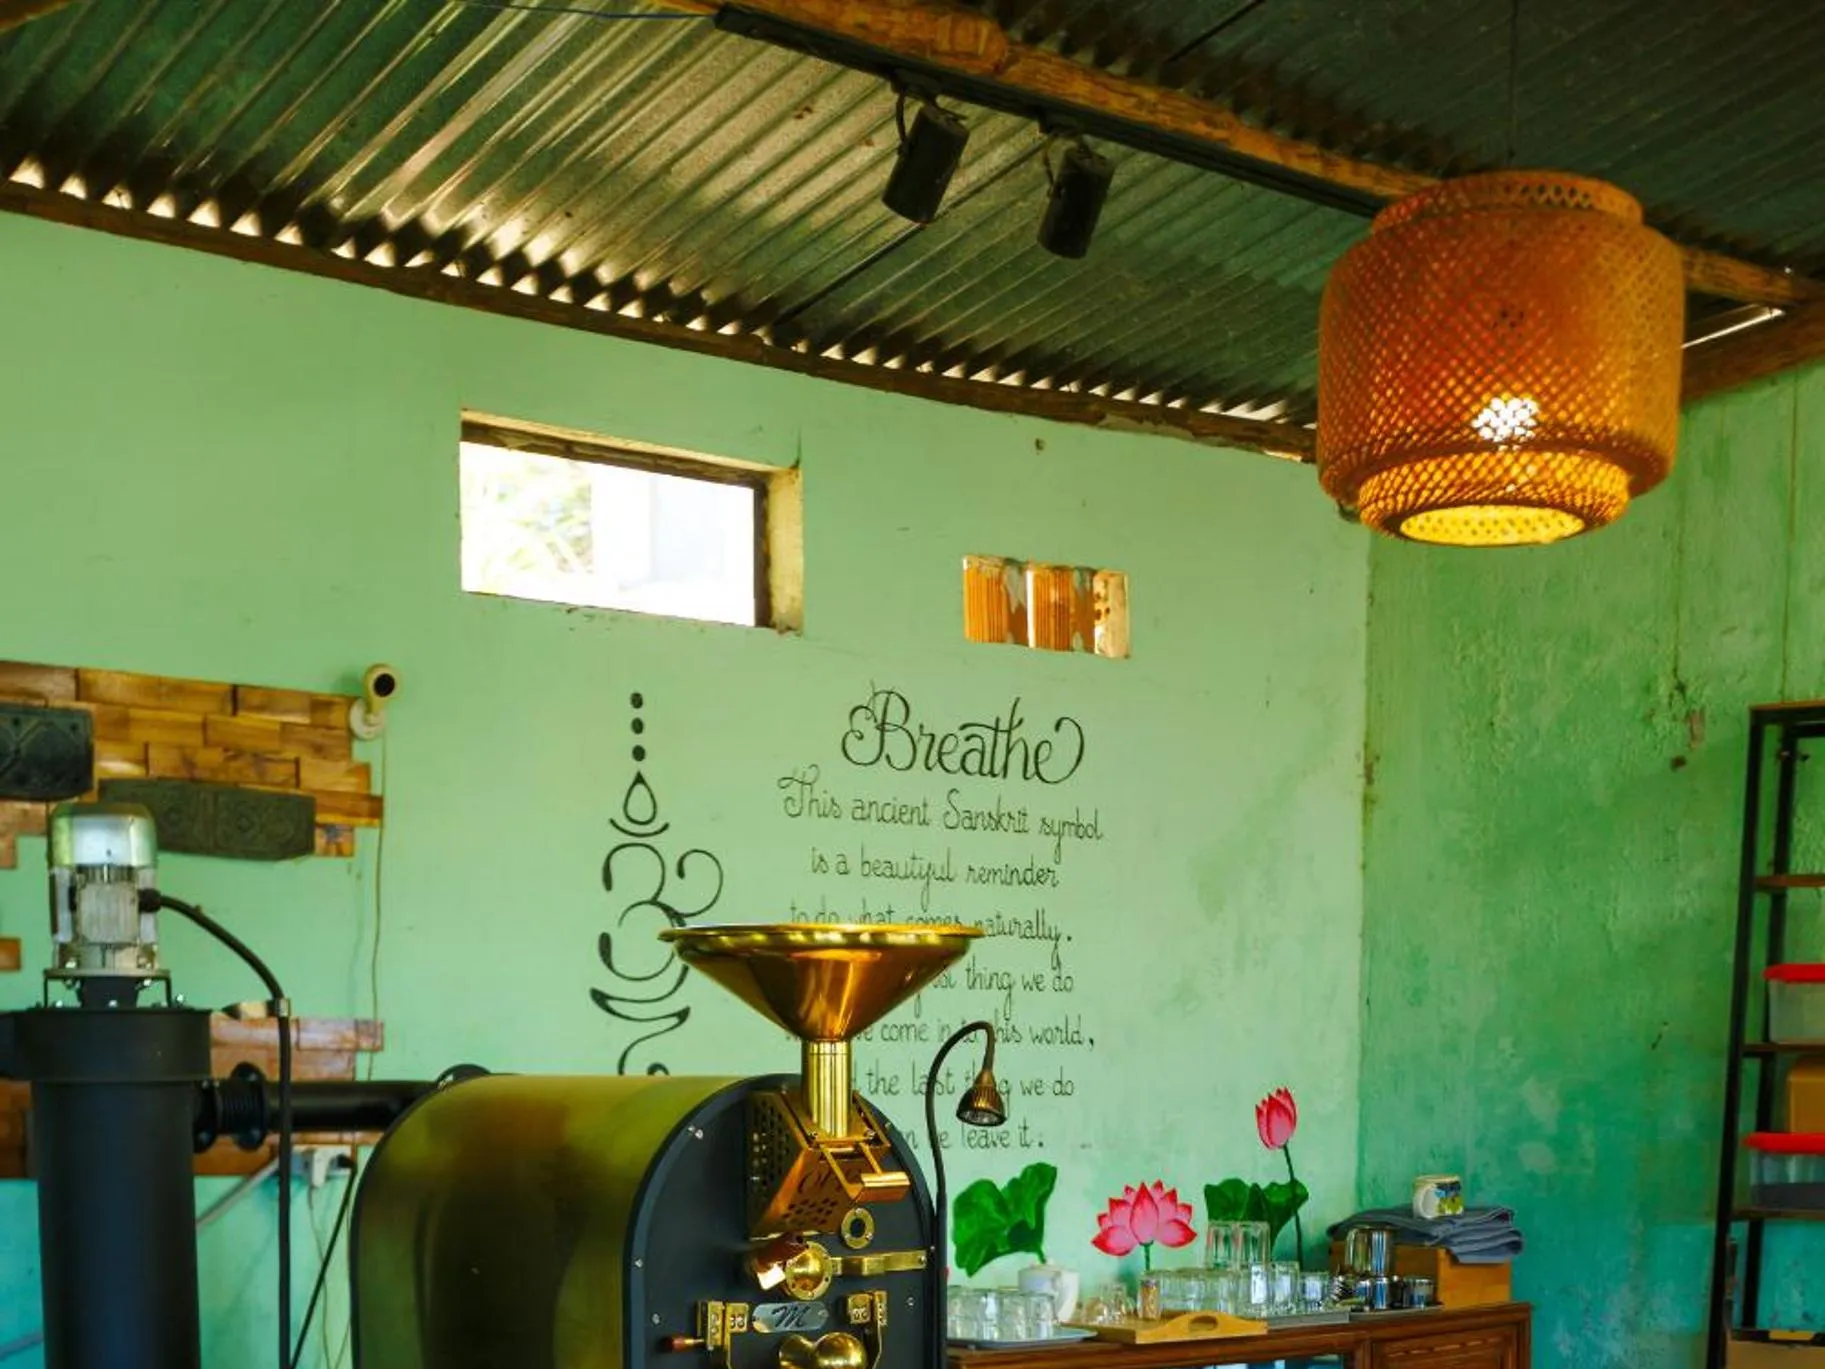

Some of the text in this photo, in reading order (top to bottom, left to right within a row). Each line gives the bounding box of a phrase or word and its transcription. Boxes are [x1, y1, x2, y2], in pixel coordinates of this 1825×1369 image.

[841, 681, 1085, 784] Breathe
[777, 764, 1103, 864] This ancient Sanskrit symbol
[811, 843, 1060, 913] is a beautiful reminder
[847, 898, 895, 924] hat
[965, 956, 1015, 1020] thing
[1022, 973, 1045, 991] we
[1052, 963, 1074, 992] do
[881, 1024, 928, 1042] come
[993, 1008, 1023, 1043] his
[866, 1058, 900, 1096] the
[1020, 1078, 1045, 1096] we
[1053, 1066, 1074, 1096] do
